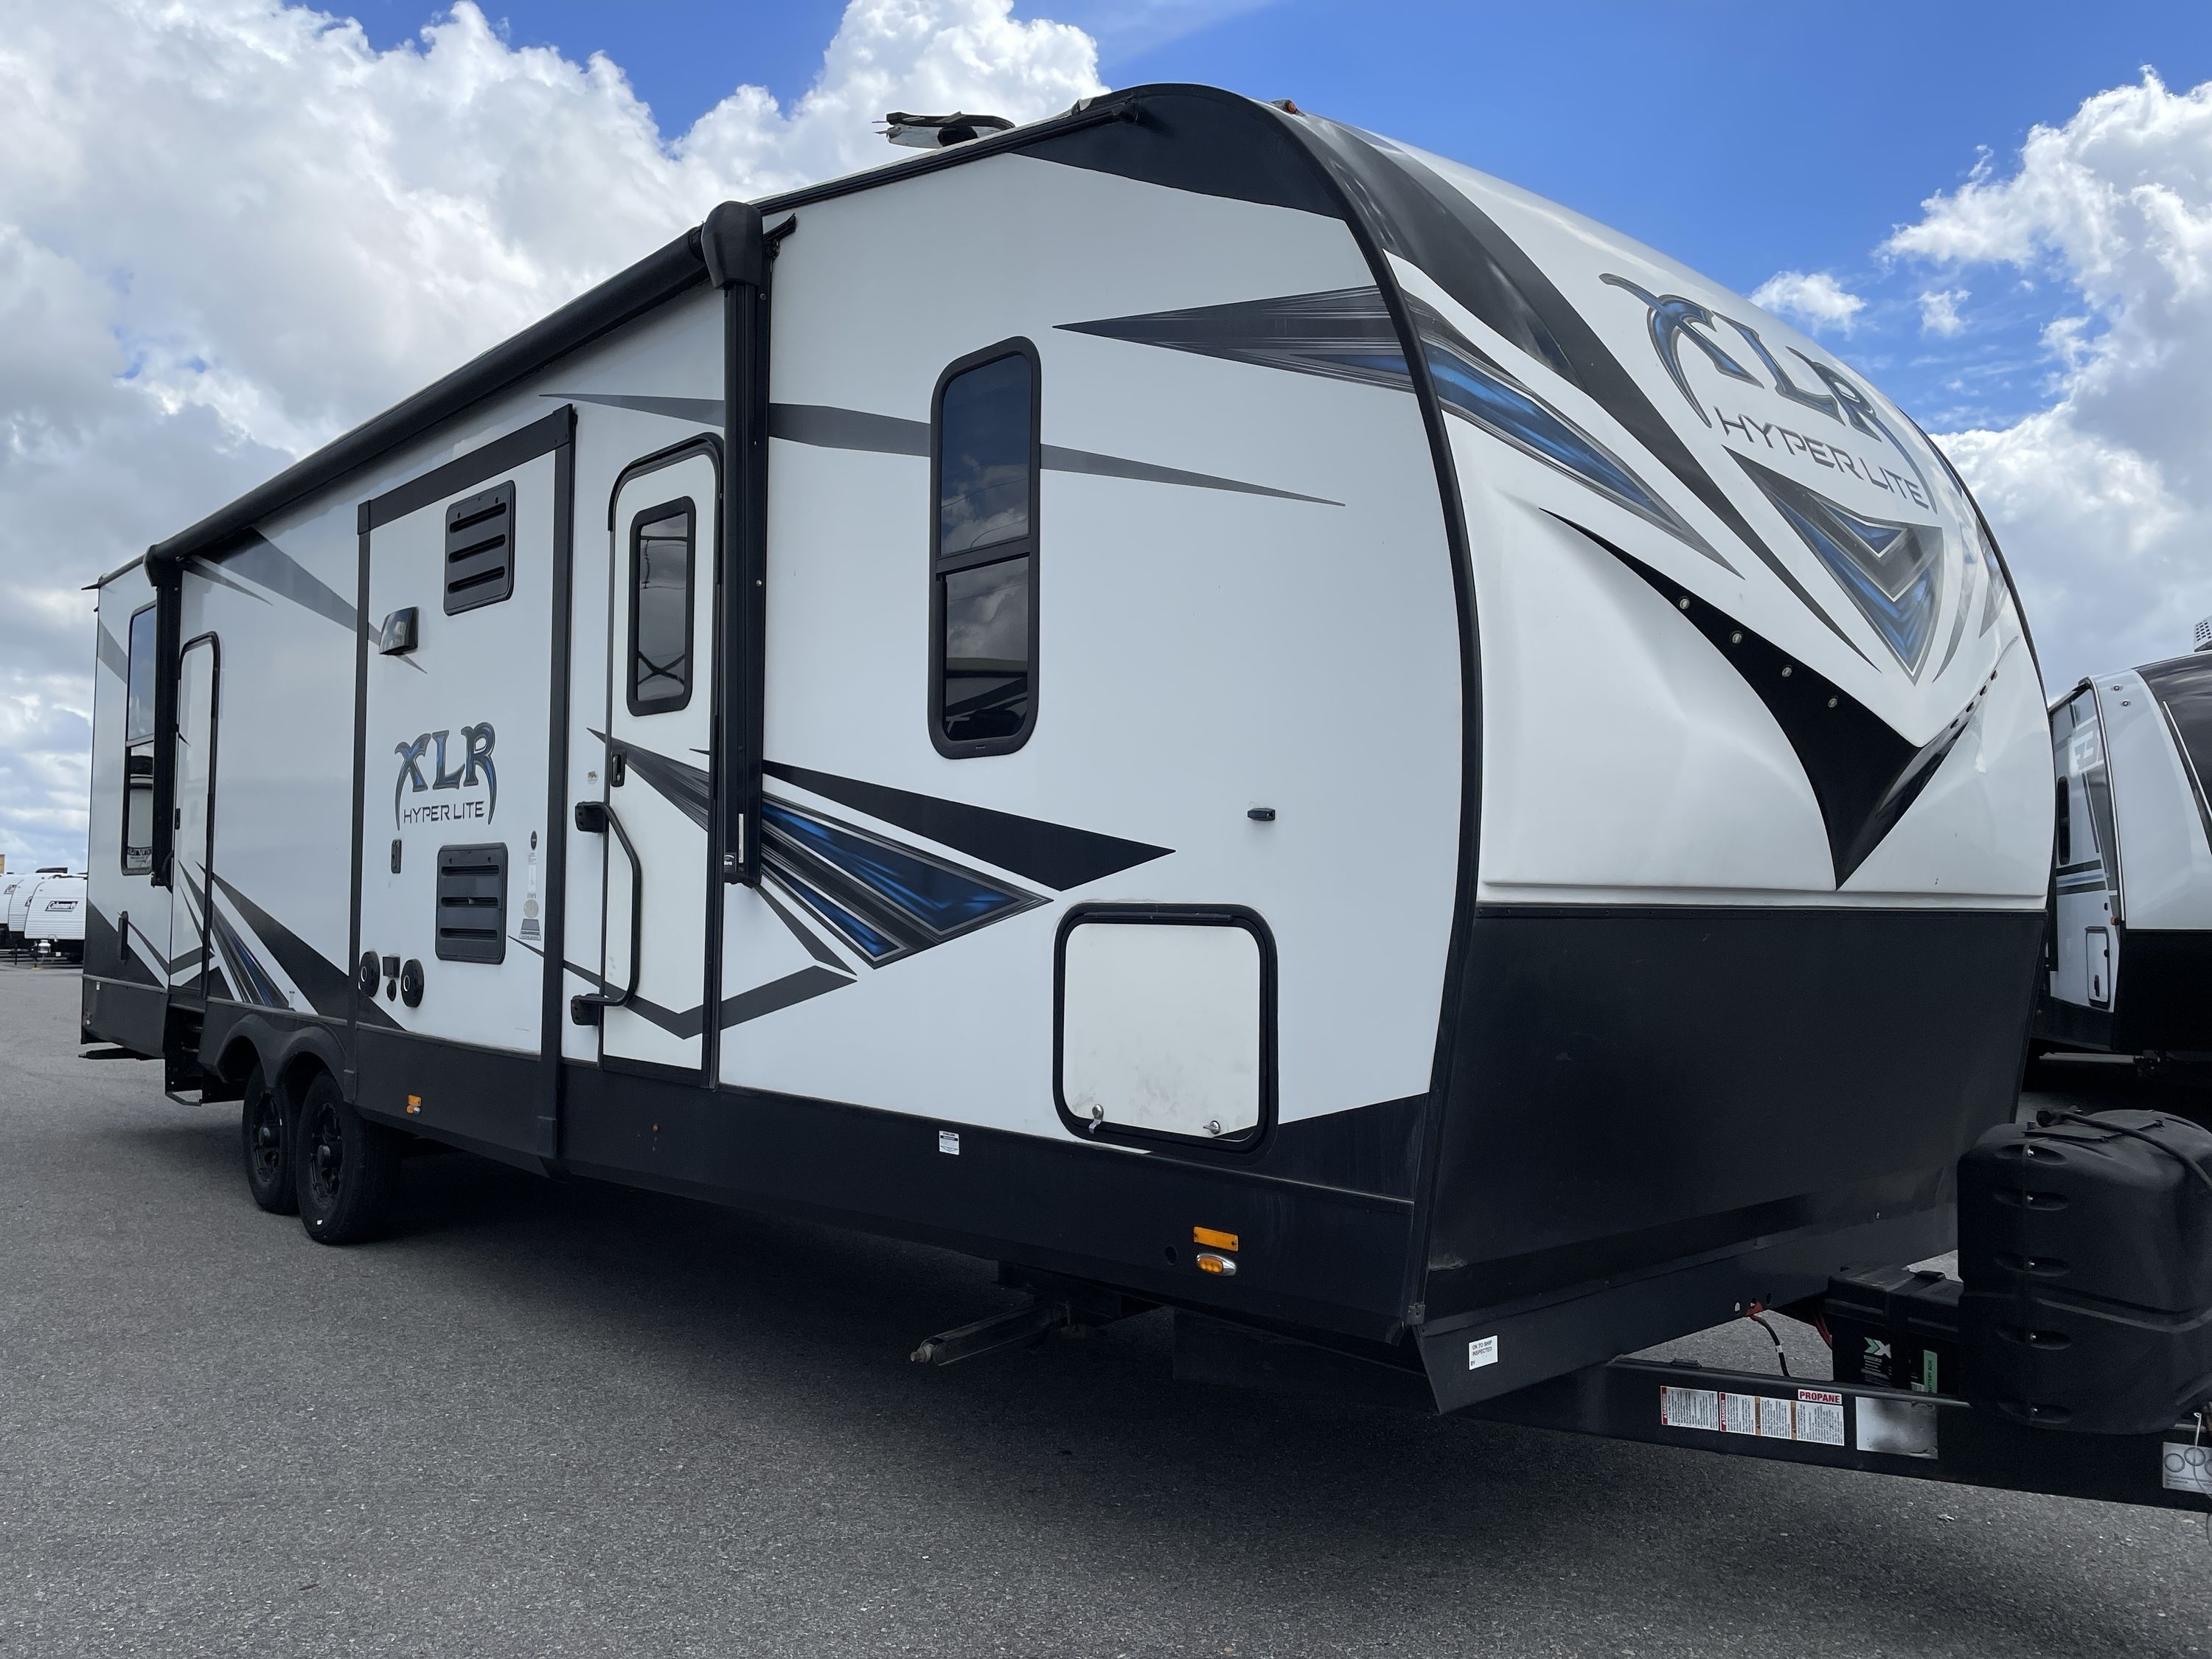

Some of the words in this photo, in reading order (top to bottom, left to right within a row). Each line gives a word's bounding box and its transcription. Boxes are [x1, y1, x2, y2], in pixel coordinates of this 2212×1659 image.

[1599, 272, 1938, 515] XLR
[1713, 405, 1865, 481] HYPER
[1859, 456, 1930, 509] LITE
[394, 721, 497, 831] XLR
[403, 804, 451, 824] HYPER
[453, 801, 484, 820] LITE
[1799, 1391, 1840, 1403] PROPANE
